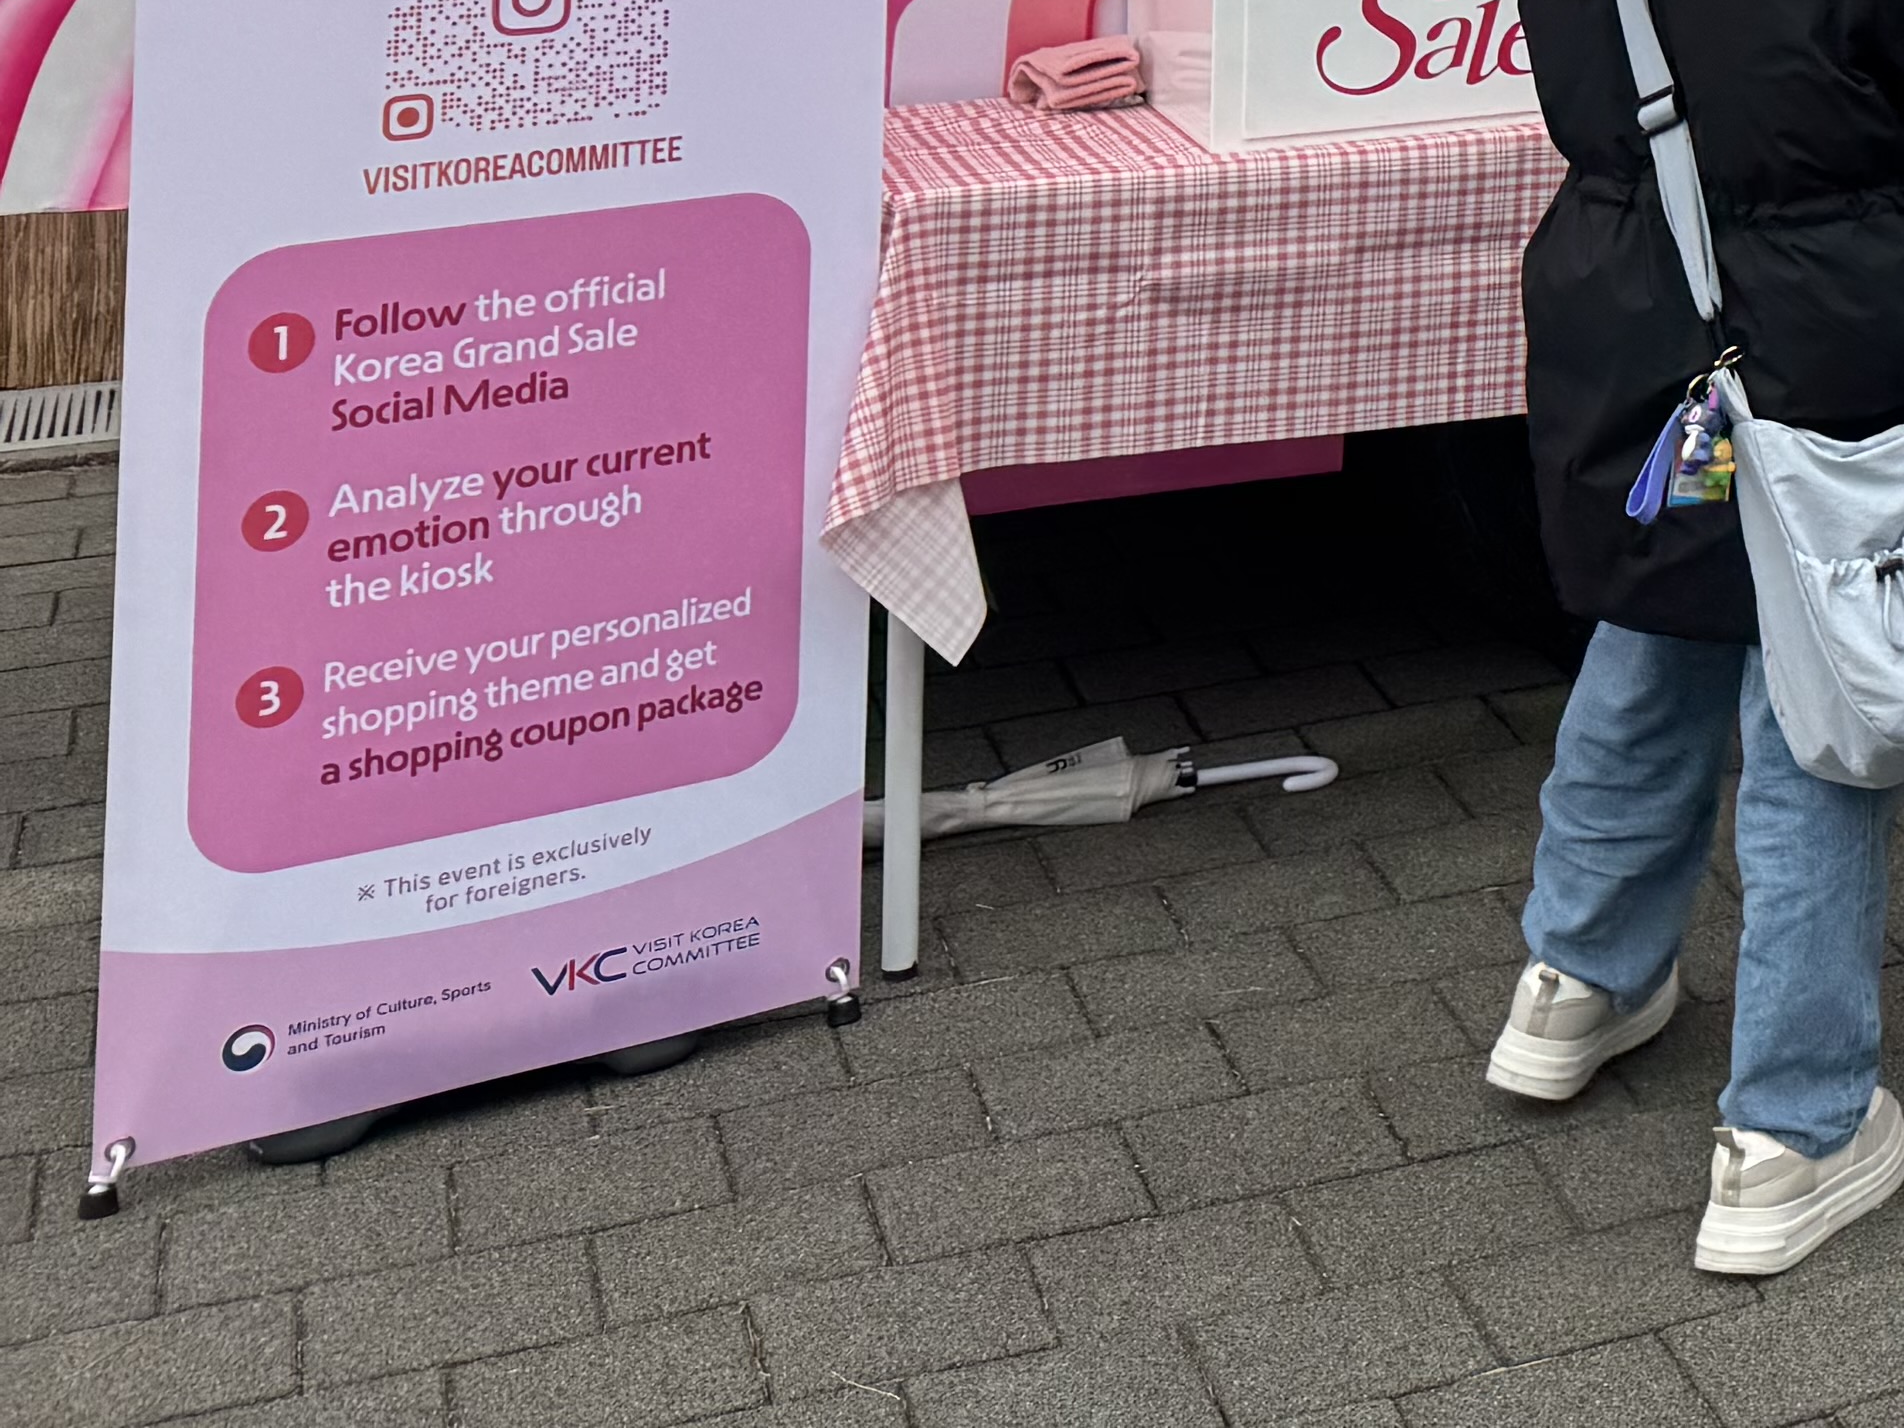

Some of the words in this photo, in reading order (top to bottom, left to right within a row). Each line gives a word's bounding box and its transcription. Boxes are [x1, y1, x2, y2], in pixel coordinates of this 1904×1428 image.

[362, 136, 684, 195] VISITKOREACOMMITTEE
[334, 300, 468, 341] Follow
[473, 288, 536, 323] the
[544, 267, 666, 313] official
[272, 325, 291, 362] 1
[332, 349, 444, 387] Korea
[453, 324, 560, 370] Grand
[567, 317, 639, 355] Sale
[331, 386, 434, 432] Social
[442, 370, 570, 416] Media
[327, 471, 485, 518] Analyze
[492, 455, 578, 501] your
[585, 431, 712, 478] current
[262, 503, 288, 542] 2
[326, 514, 490, 563] emotion
[498, 483, 642, 536] through
[324, 572, 391, 609] the
[399, 550, 494, 597] kiosk
[322, 646, 459, 693] Receive
[464, 630, 547, 675] your
[549, 586, 753, 660] personalized
[256, 679, 281, 718] 3
[320, 686, 478, 741] shopping
[484, 665, 595, 711] theme
[599, 647, 661, 687] and
[664, 639, 719, 682] get
[319, 762, 341, 786] a
[347, 727, 503, 782] shopping
[509, 699, 631, 749] coupon
[636, 677, 764, 733] package
[383, 872, 431, 898] This
[437, 857, 502, 887] event
[507, 852, 526, 872] is
[531, 825, 653, 866] exclusively
[424, 890, 460, 914] for
[464, 864, 587, 906] foreigners.
[631, 932, 686, 955] VISIT
[689, 915, 760, 942] KOREA
[631, 931, 761, 976] COMMITTEE
[530, 945, 628, 996] VKC
[286, 1010, 353, 1037] Ministry
[355, 1004, 373, 1022] of
[375, 994, 438, 1017] Culture,
[440, 980, 492, 1002] Sports
[286, 1035, 320, 1056] and
[323, 1023, 386, 1048] Tourism
